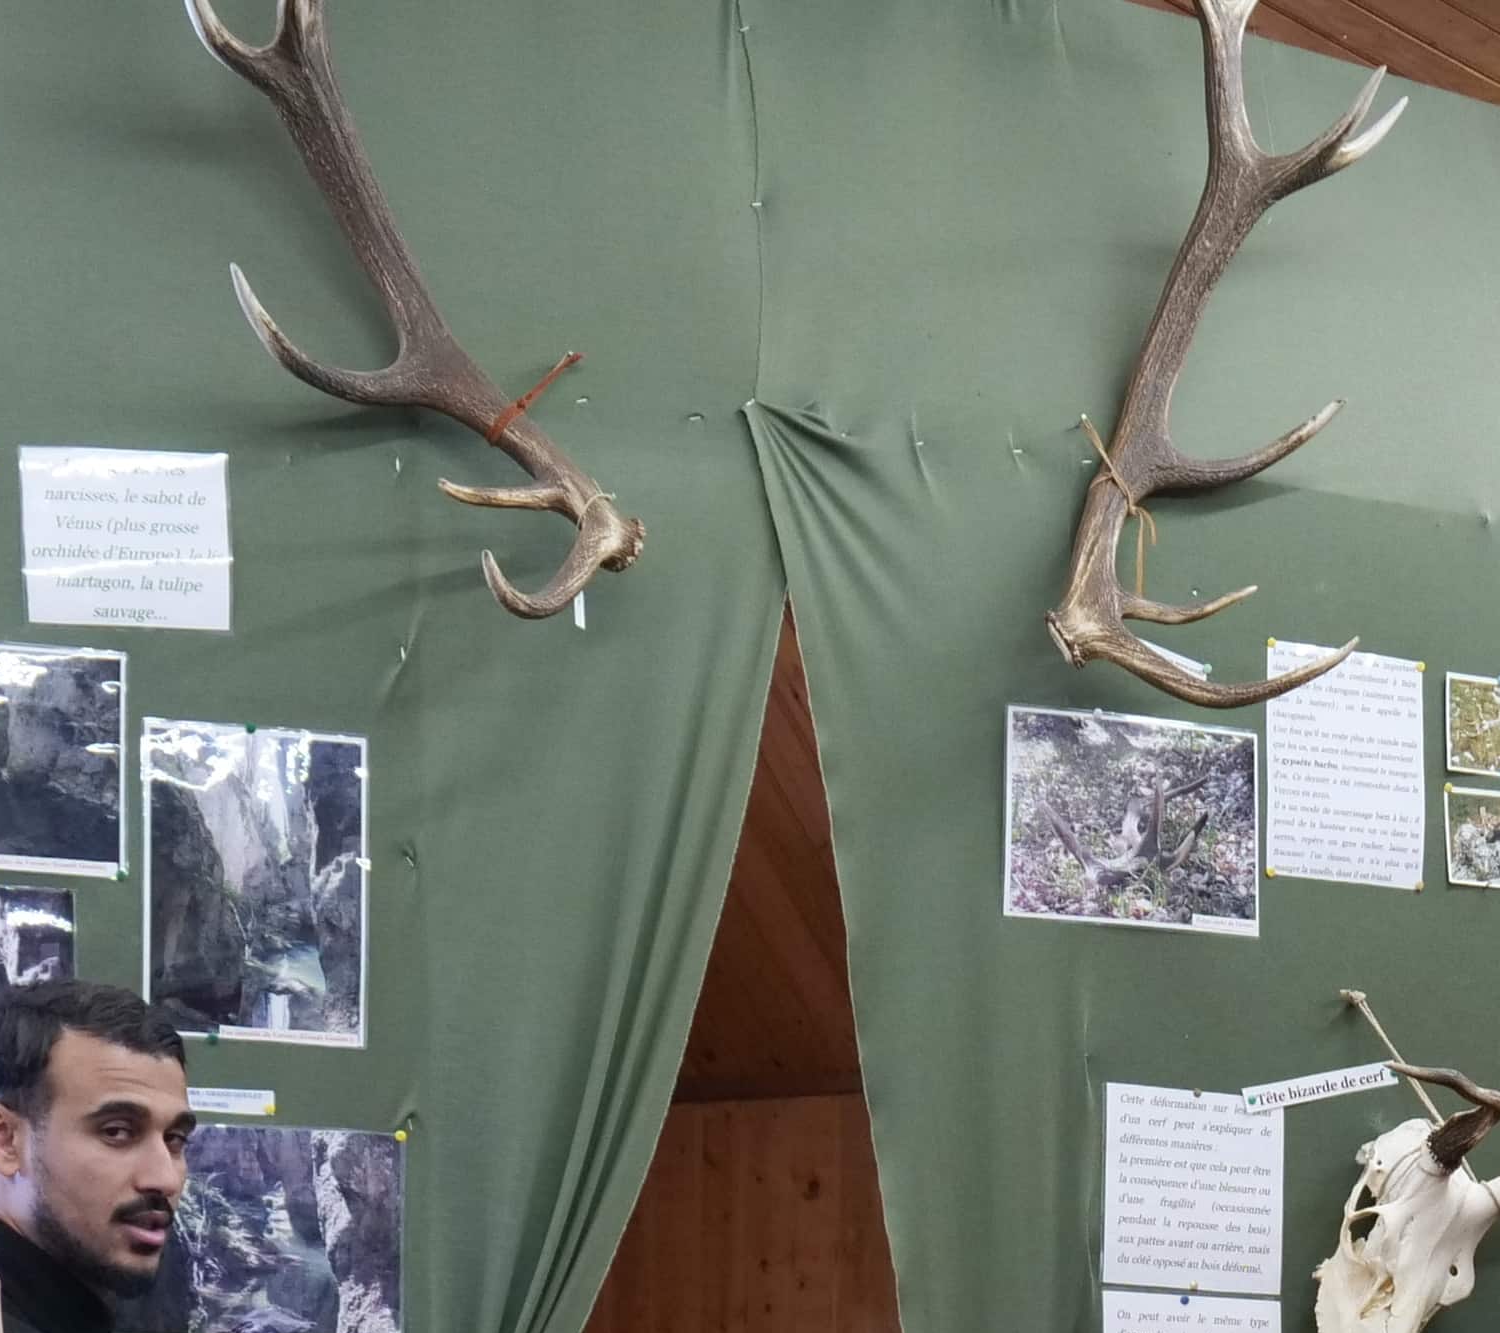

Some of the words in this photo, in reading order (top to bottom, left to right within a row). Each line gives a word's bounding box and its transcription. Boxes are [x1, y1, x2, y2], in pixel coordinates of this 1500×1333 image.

[1257, 1086, 1285, 1106] Tête
[1289, 1078, 1338, 1099] bizarde
[1341, 1074, 1357, 1088] de
[1360, 1069, 1385, 1086] cerf
